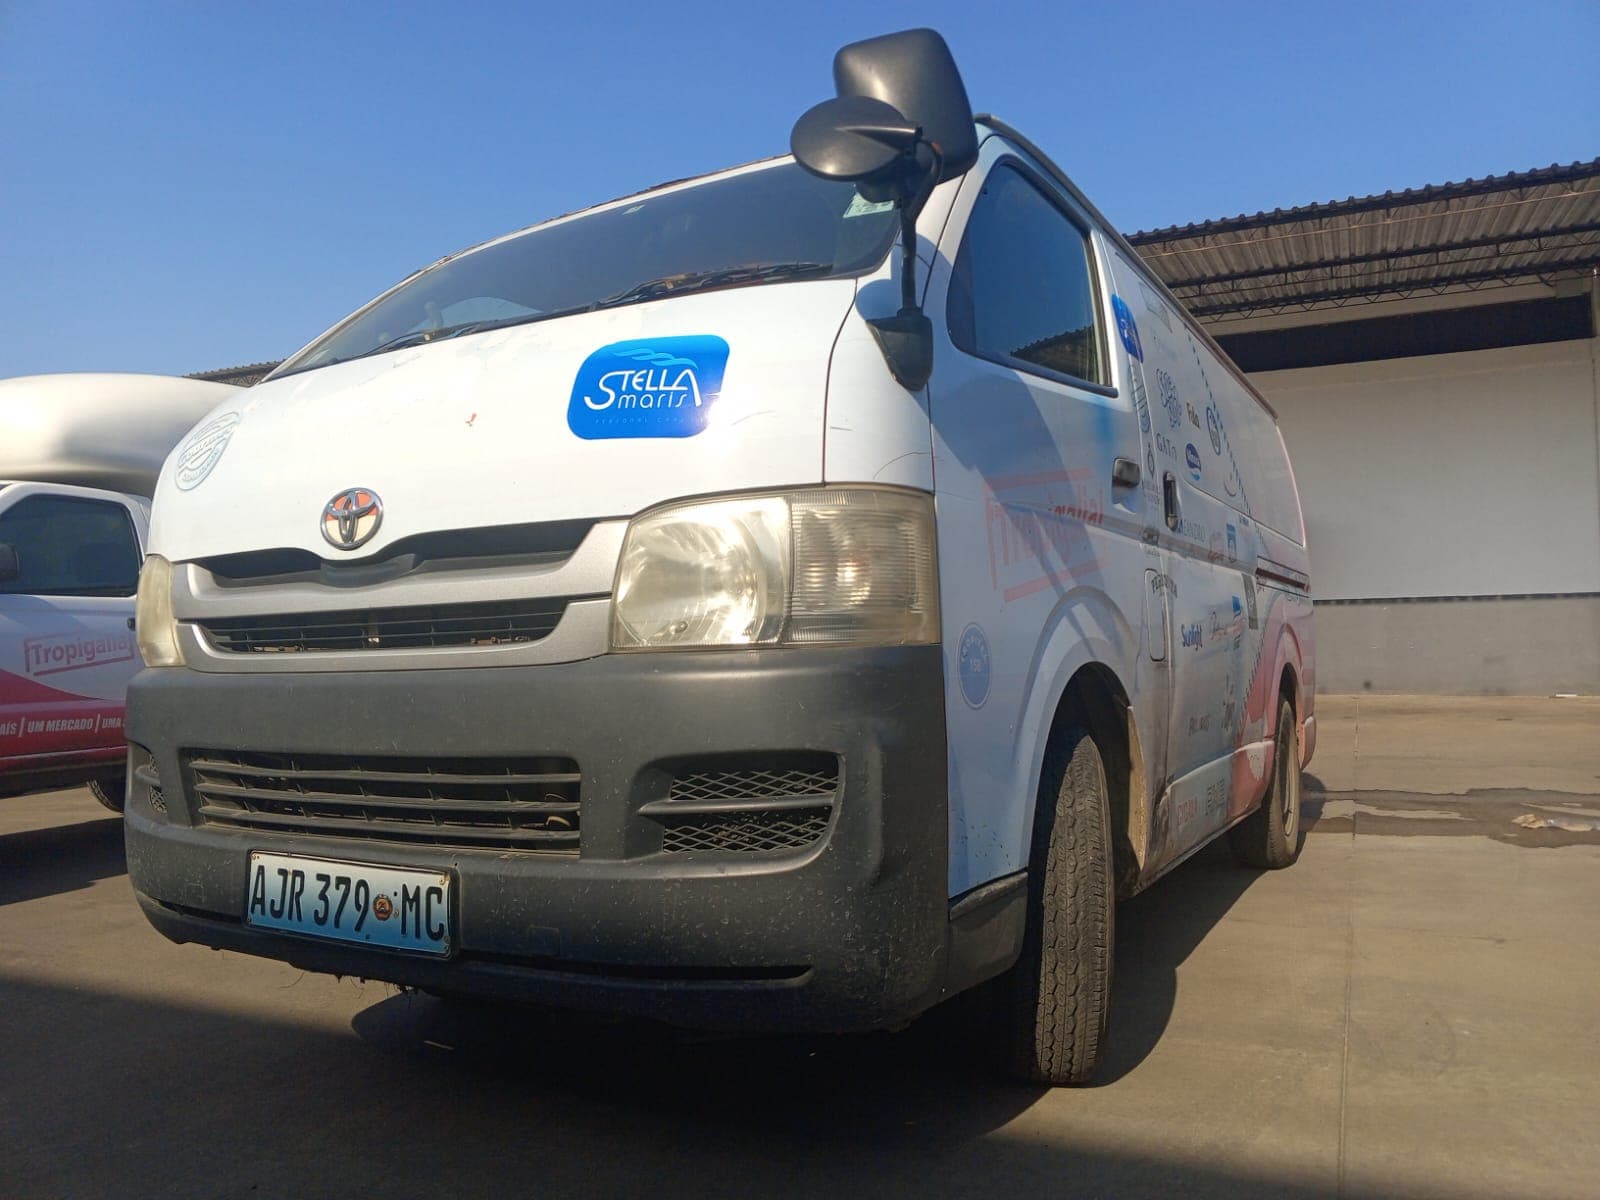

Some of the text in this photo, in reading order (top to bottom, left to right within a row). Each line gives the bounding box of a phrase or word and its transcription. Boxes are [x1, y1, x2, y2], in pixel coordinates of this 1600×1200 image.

[583, 368, 703, 410] STELLA
[31, 636, 127, 664] Tropigalia
[27, 720, 45, 733] UM
[46, 718, 94, 731] MERCADO
[102, 717, 121, 728] UMA
[250, 864, 445, 942] AJR 379 MC
